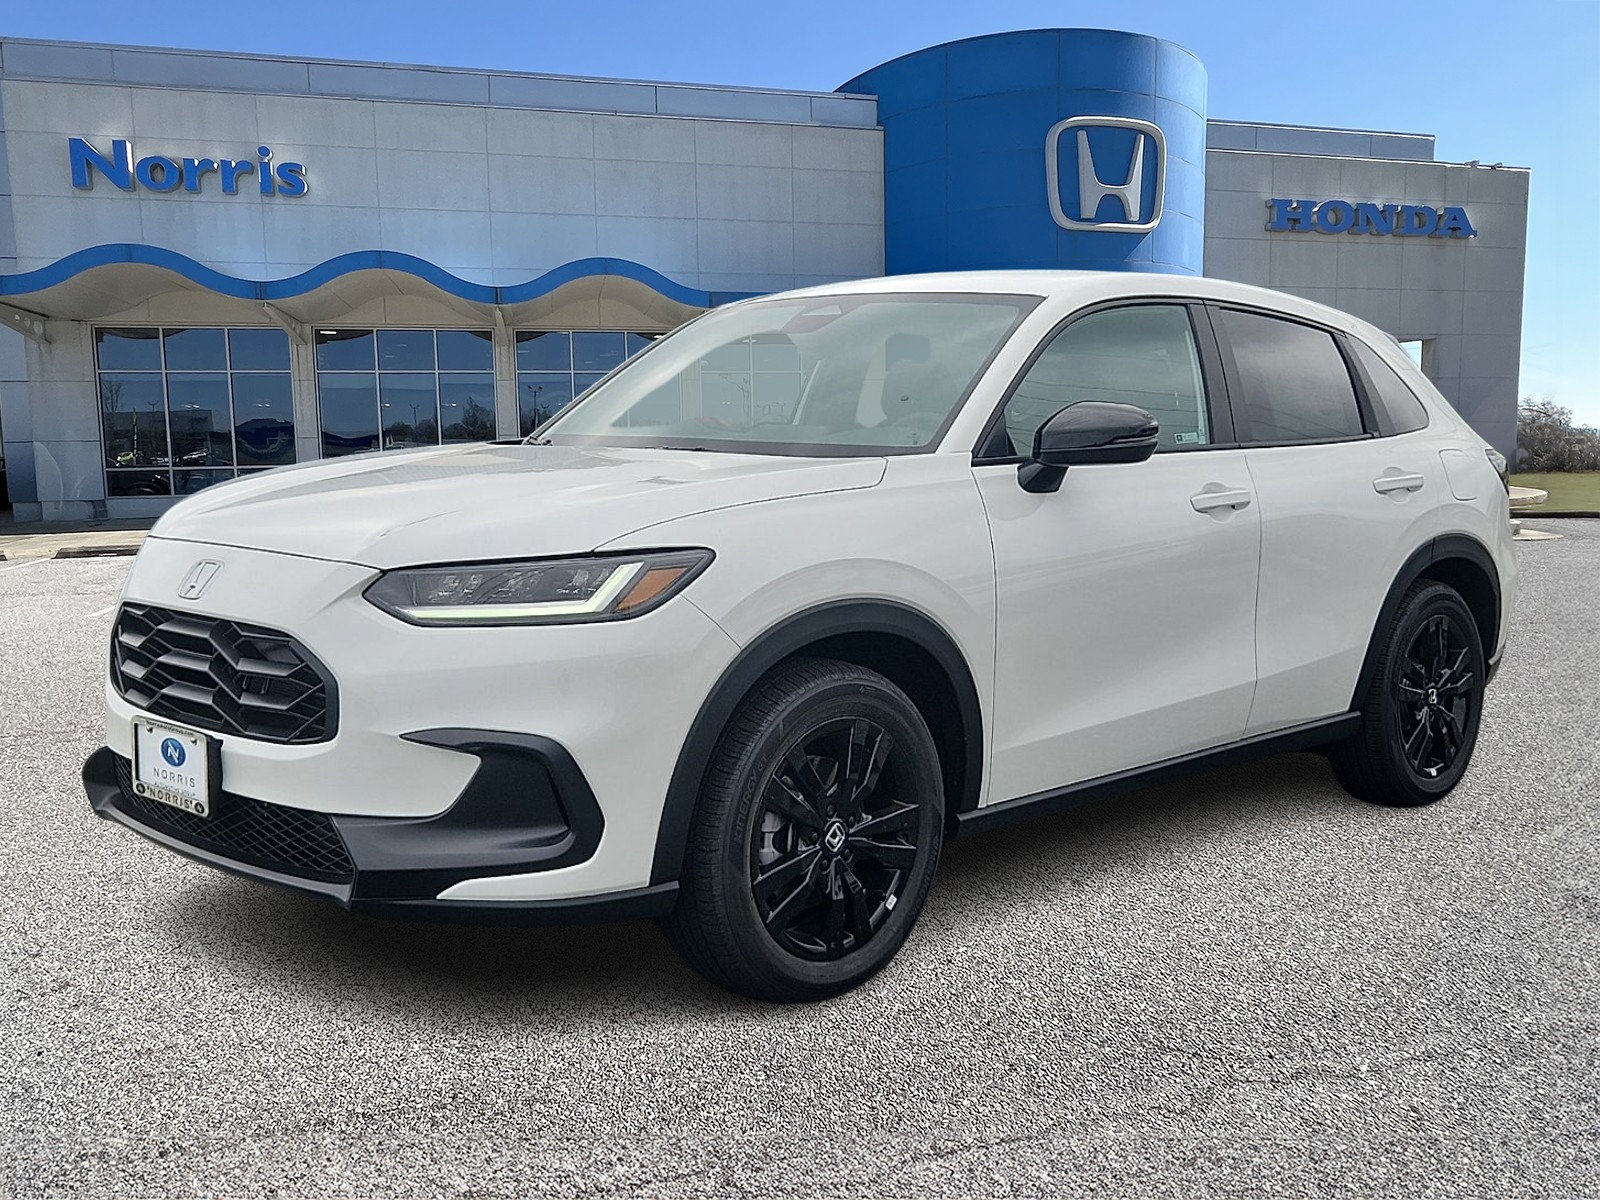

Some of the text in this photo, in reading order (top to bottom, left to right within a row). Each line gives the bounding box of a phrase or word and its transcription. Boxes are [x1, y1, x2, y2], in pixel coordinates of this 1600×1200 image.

[68, 137, 308, 197] Norris
[1266, 198, 1477, 238] HONDA
[153, 767, 196, 788] NORRIS
